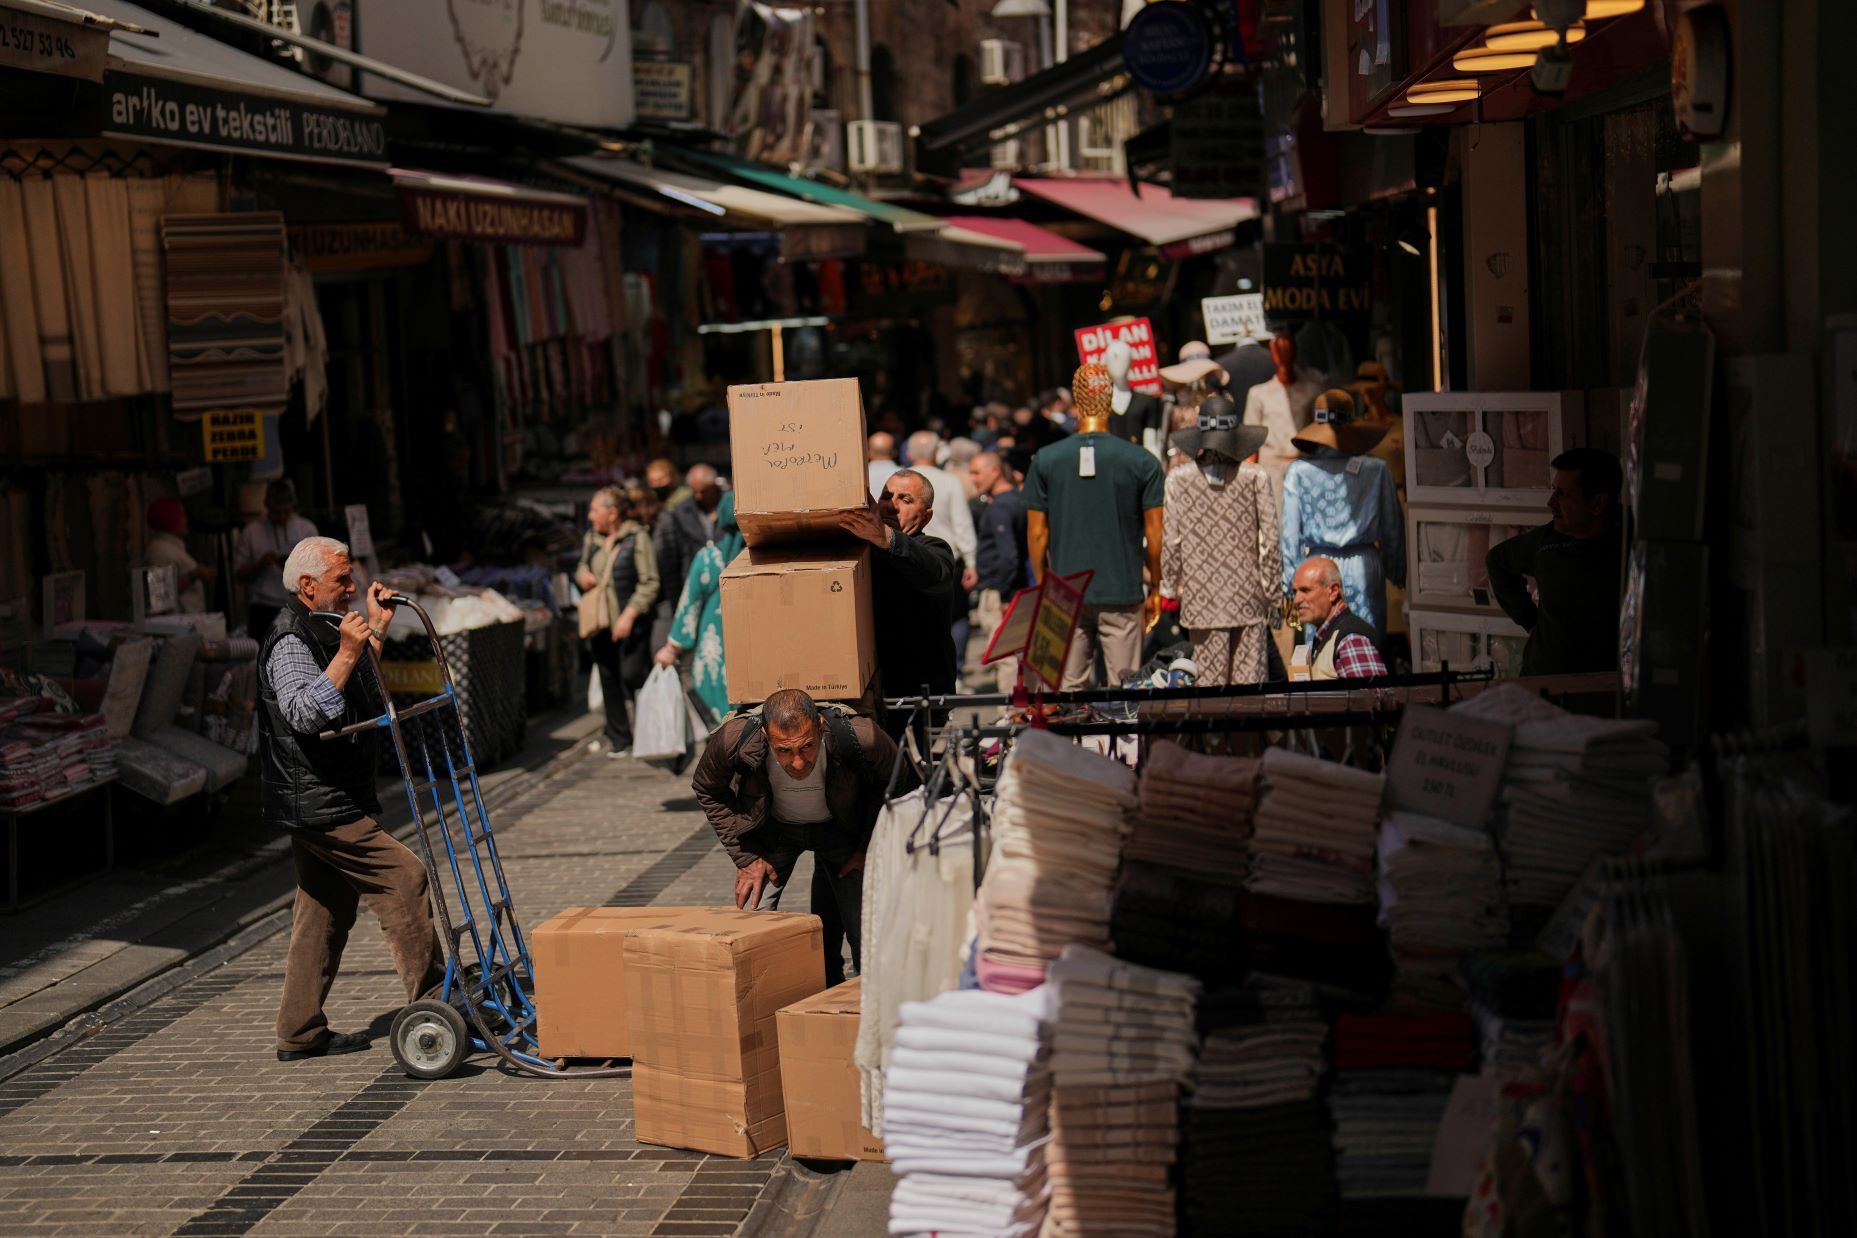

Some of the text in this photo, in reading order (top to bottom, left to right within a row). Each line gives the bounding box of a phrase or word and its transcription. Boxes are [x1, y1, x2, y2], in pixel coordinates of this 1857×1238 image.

[11, 27, 34, 51] 527
[39, 32, 52, 56] 53
[56, 37, 76, 58] 96
[185, 102, 212, 135] ev
[216, 101, 293, 146] tekstili
[470, 201, 577, 240] UZUNHASAN
[1289, 253, 1345, 278] ASYA
[1264, 286, 1332, 312] MODA
[1081, 323, 1149, 352] DİLAN
[213, 444, 257, 458] PERDE
